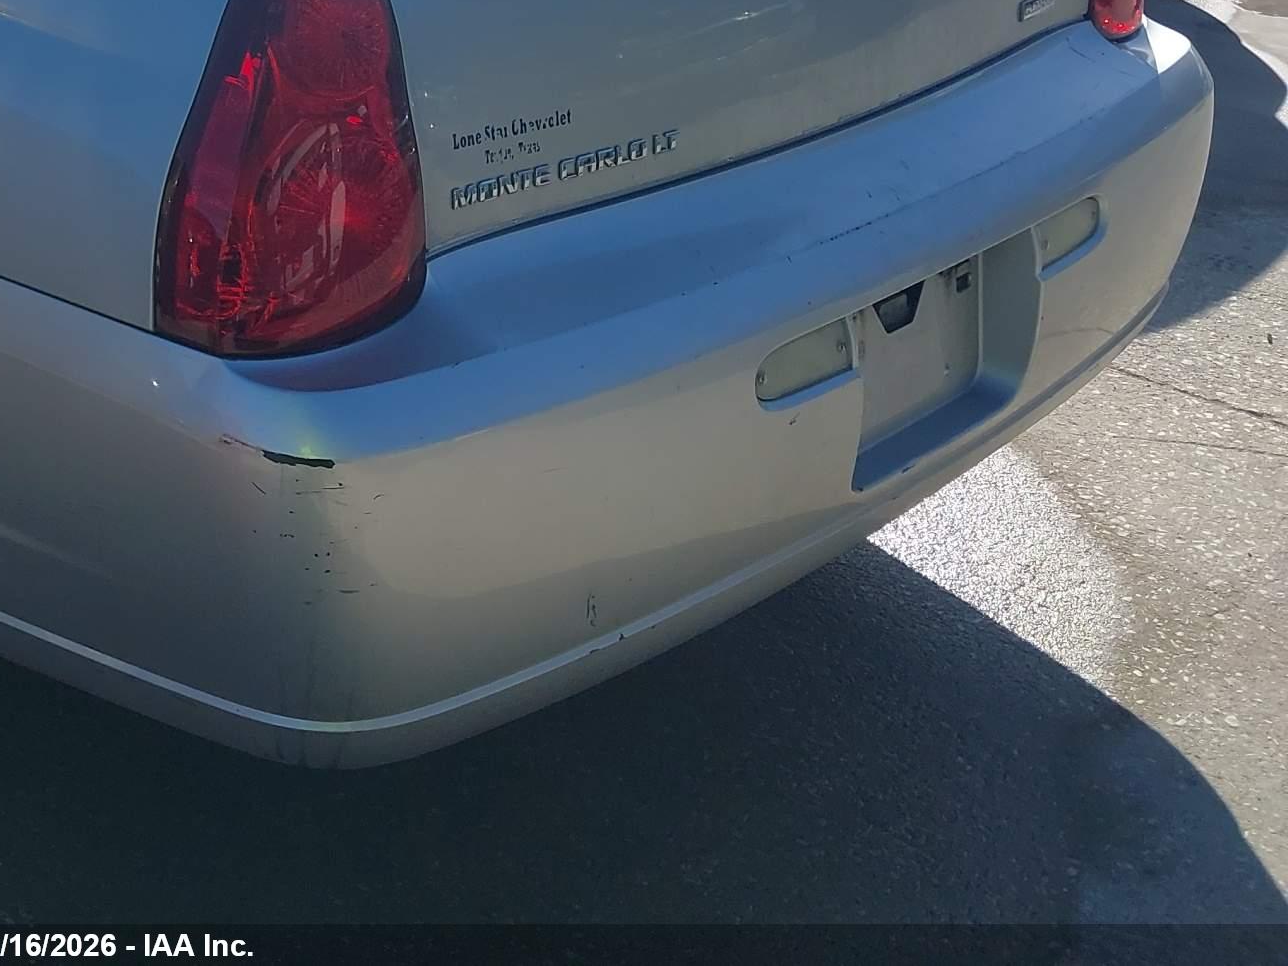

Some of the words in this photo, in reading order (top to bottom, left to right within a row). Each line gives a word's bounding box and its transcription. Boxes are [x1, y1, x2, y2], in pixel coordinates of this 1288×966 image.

[453, 132, 482, 150] Lone
[451, 163, 551, 210] MONTE
[558, 138, 647, 181] CARLO
[652, 129, 680, 155] LT
